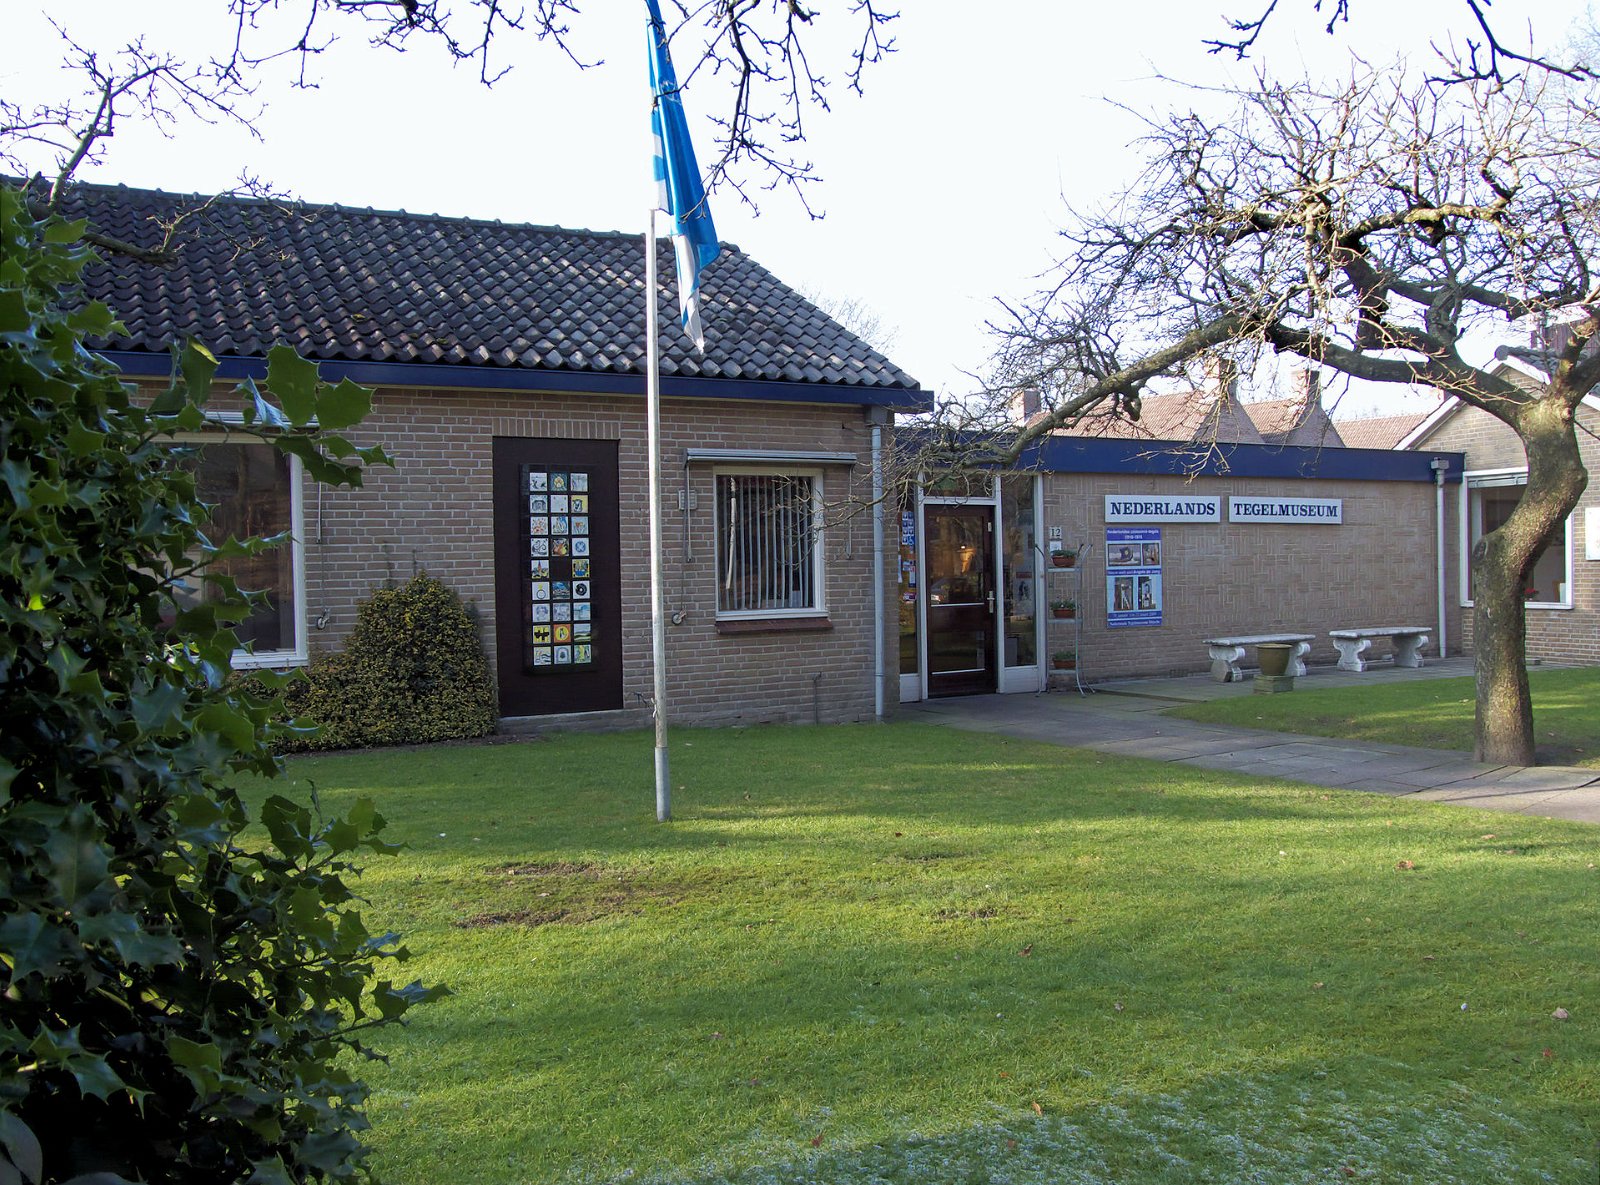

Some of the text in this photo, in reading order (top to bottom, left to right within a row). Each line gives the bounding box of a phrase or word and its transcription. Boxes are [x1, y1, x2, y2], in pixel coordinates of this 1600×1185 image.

[1110, 502, 1338, 518] NEDERLANDS TEGELMUSEUM
[1051, 528, 1061, 537] 12
